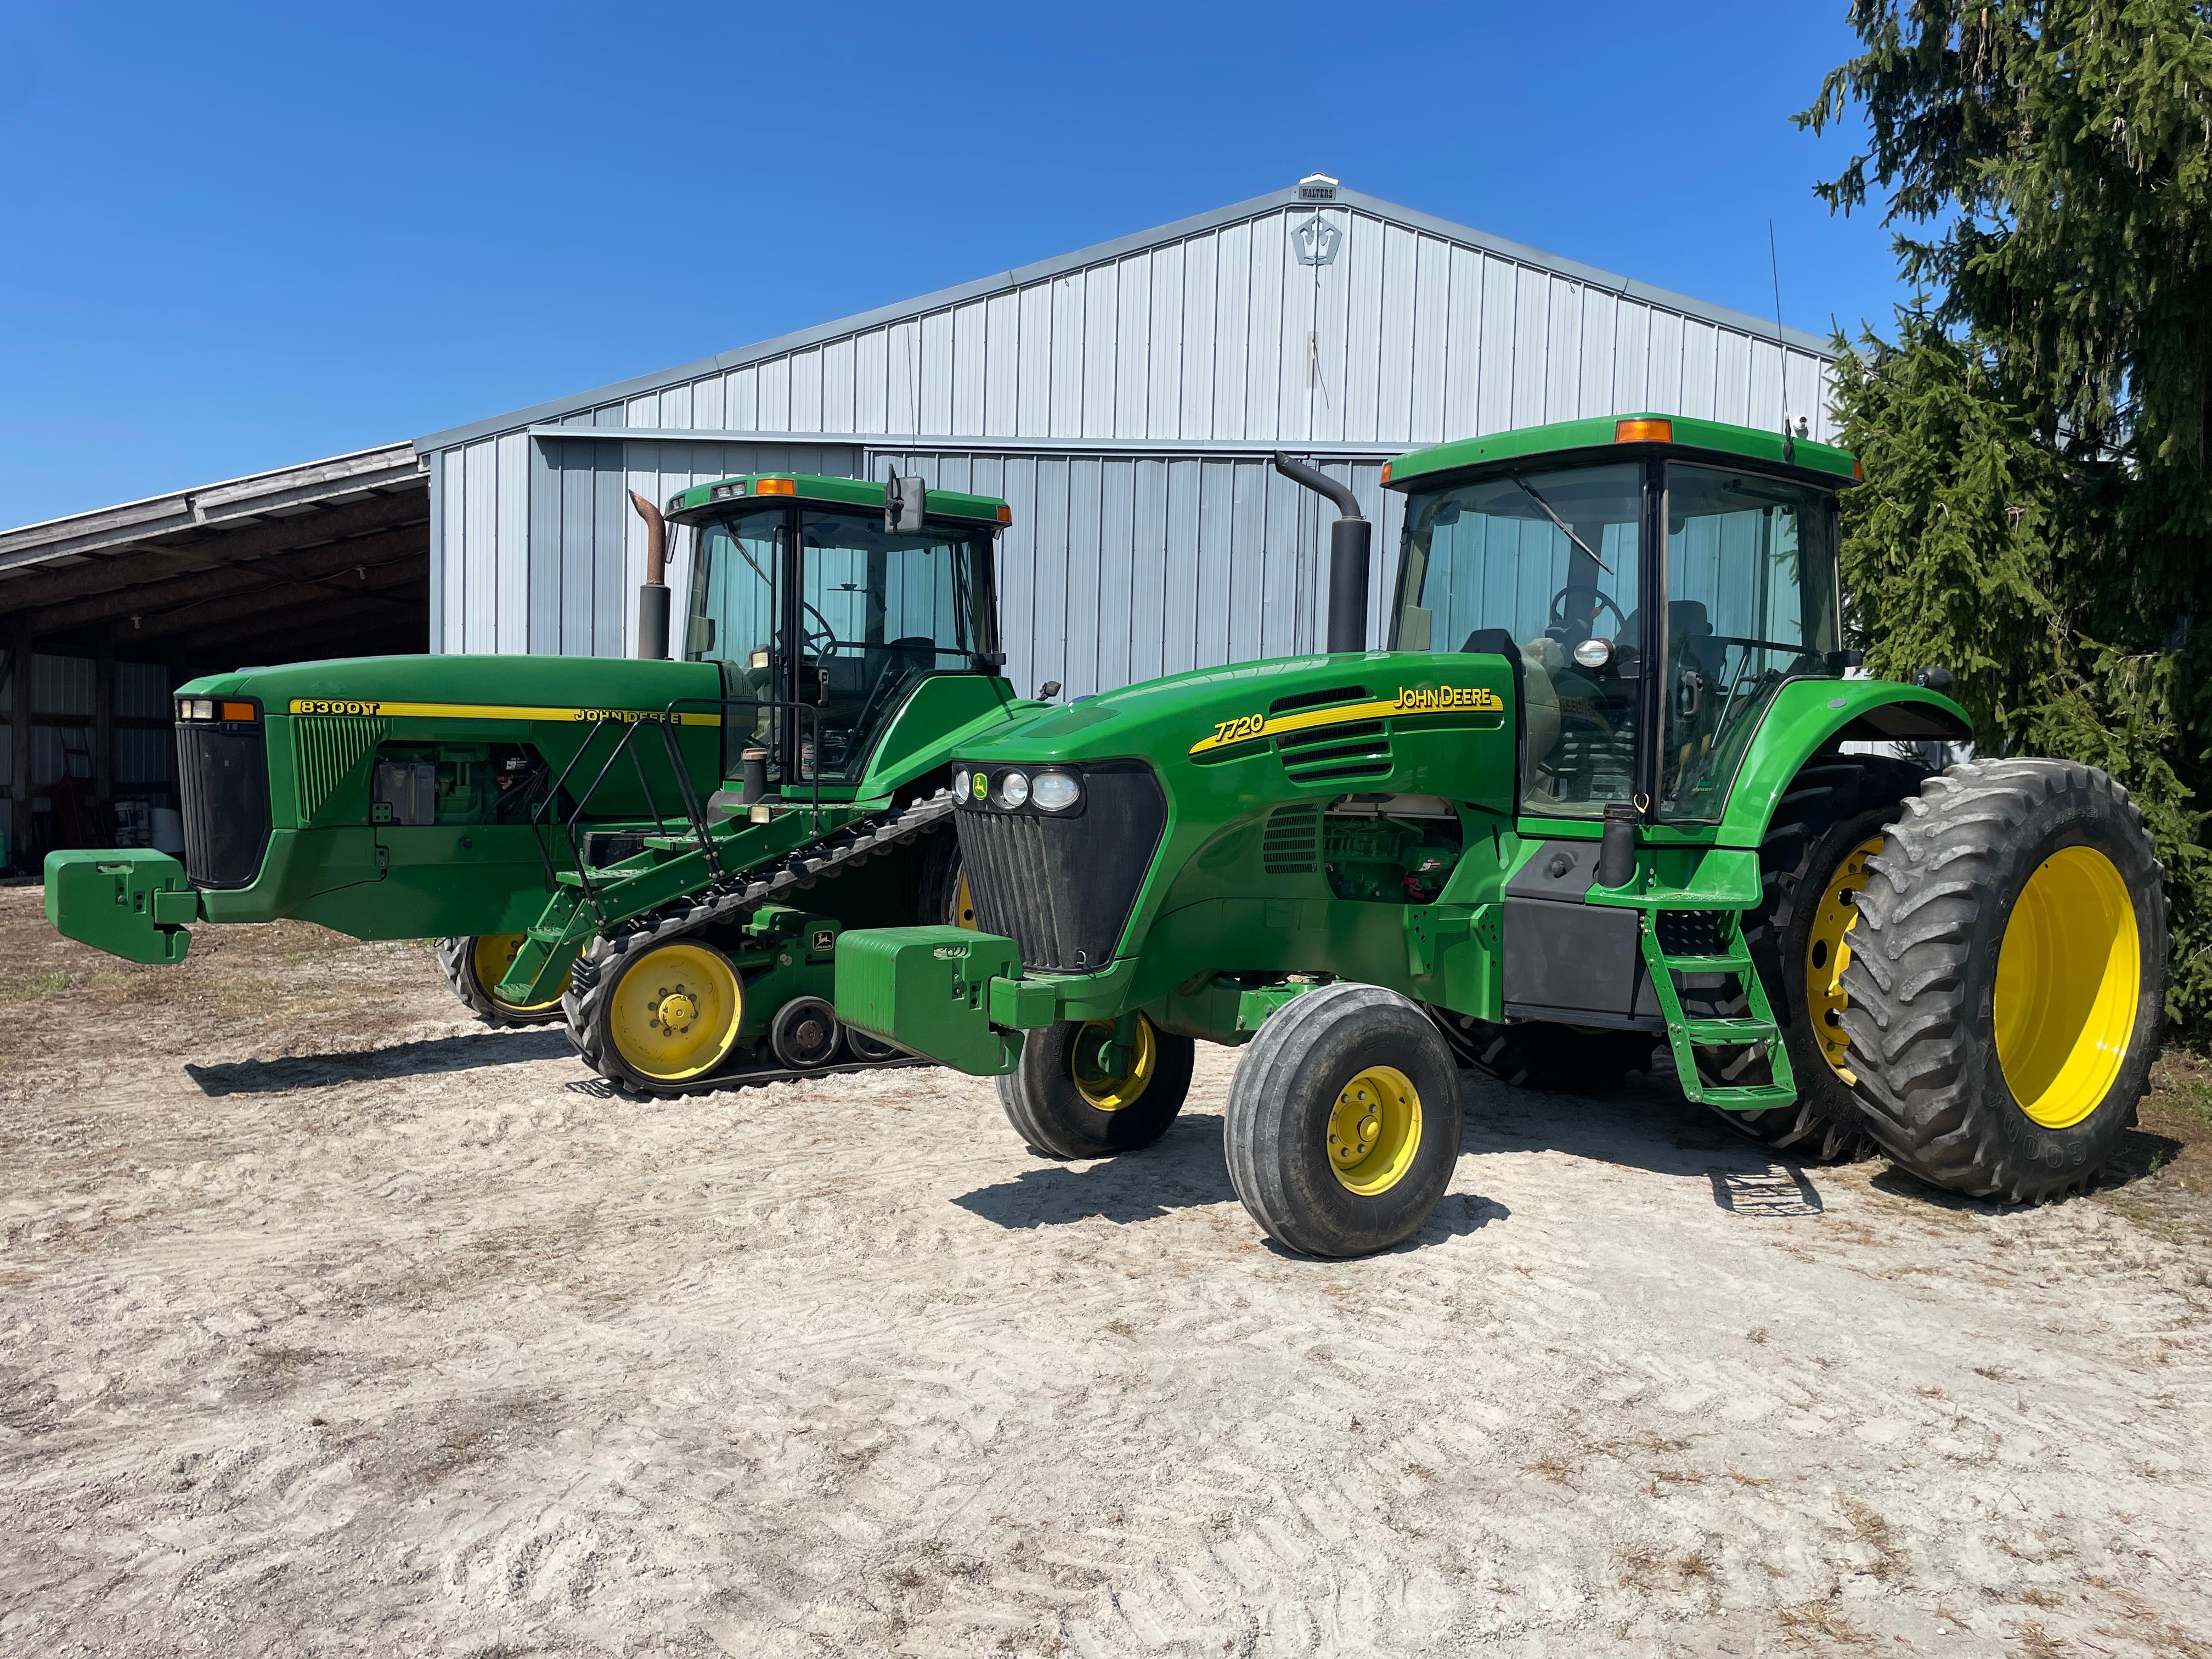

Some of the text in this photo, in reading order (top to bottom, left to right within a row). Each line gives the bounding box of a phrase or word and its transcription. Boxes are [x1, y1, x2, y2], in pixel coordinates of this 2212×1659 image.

[1302, 188, 1333, 198] WALTERS
[1393, 685, 1492, 709] JOHN DEERE
[301, 701, 380, 715] 8300T
[575, 709, 622, 722] JOHN
[1215, 713, 1264, 743] 7720
